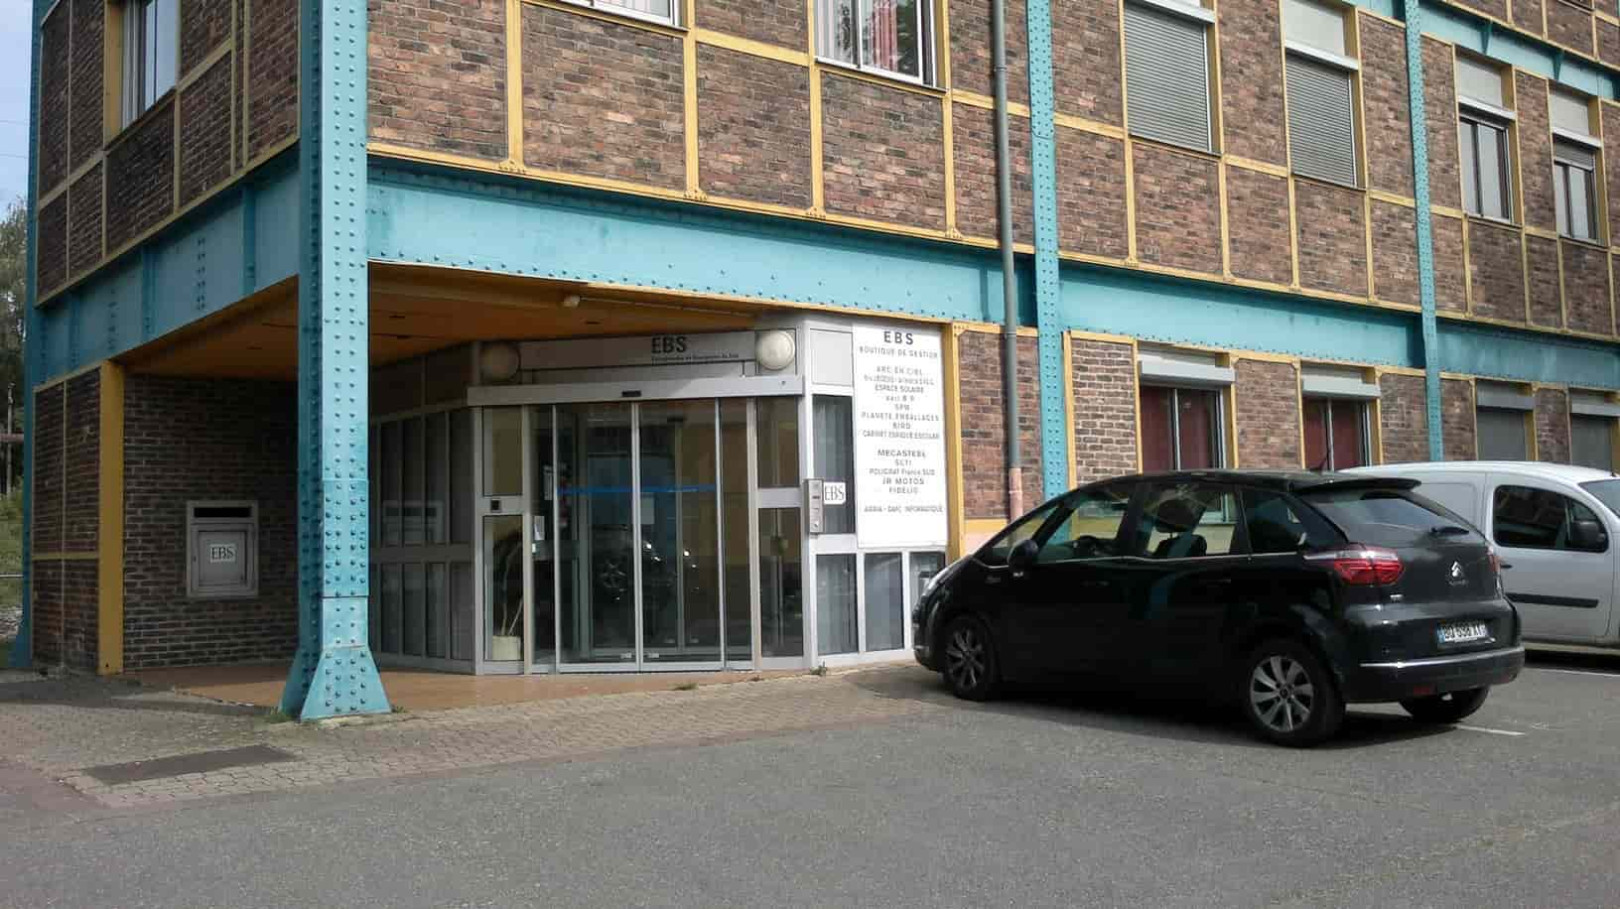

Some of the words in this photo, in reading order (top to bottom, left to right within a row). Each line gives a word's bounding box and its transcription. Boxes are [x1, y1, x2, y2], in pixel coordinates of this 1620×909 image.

[651, 336, 687, 353] EBS
[884, 330, 914, 345] EBS
[824, 482, 844, 500] EBS
[211, 546, 234, 560] EBS
